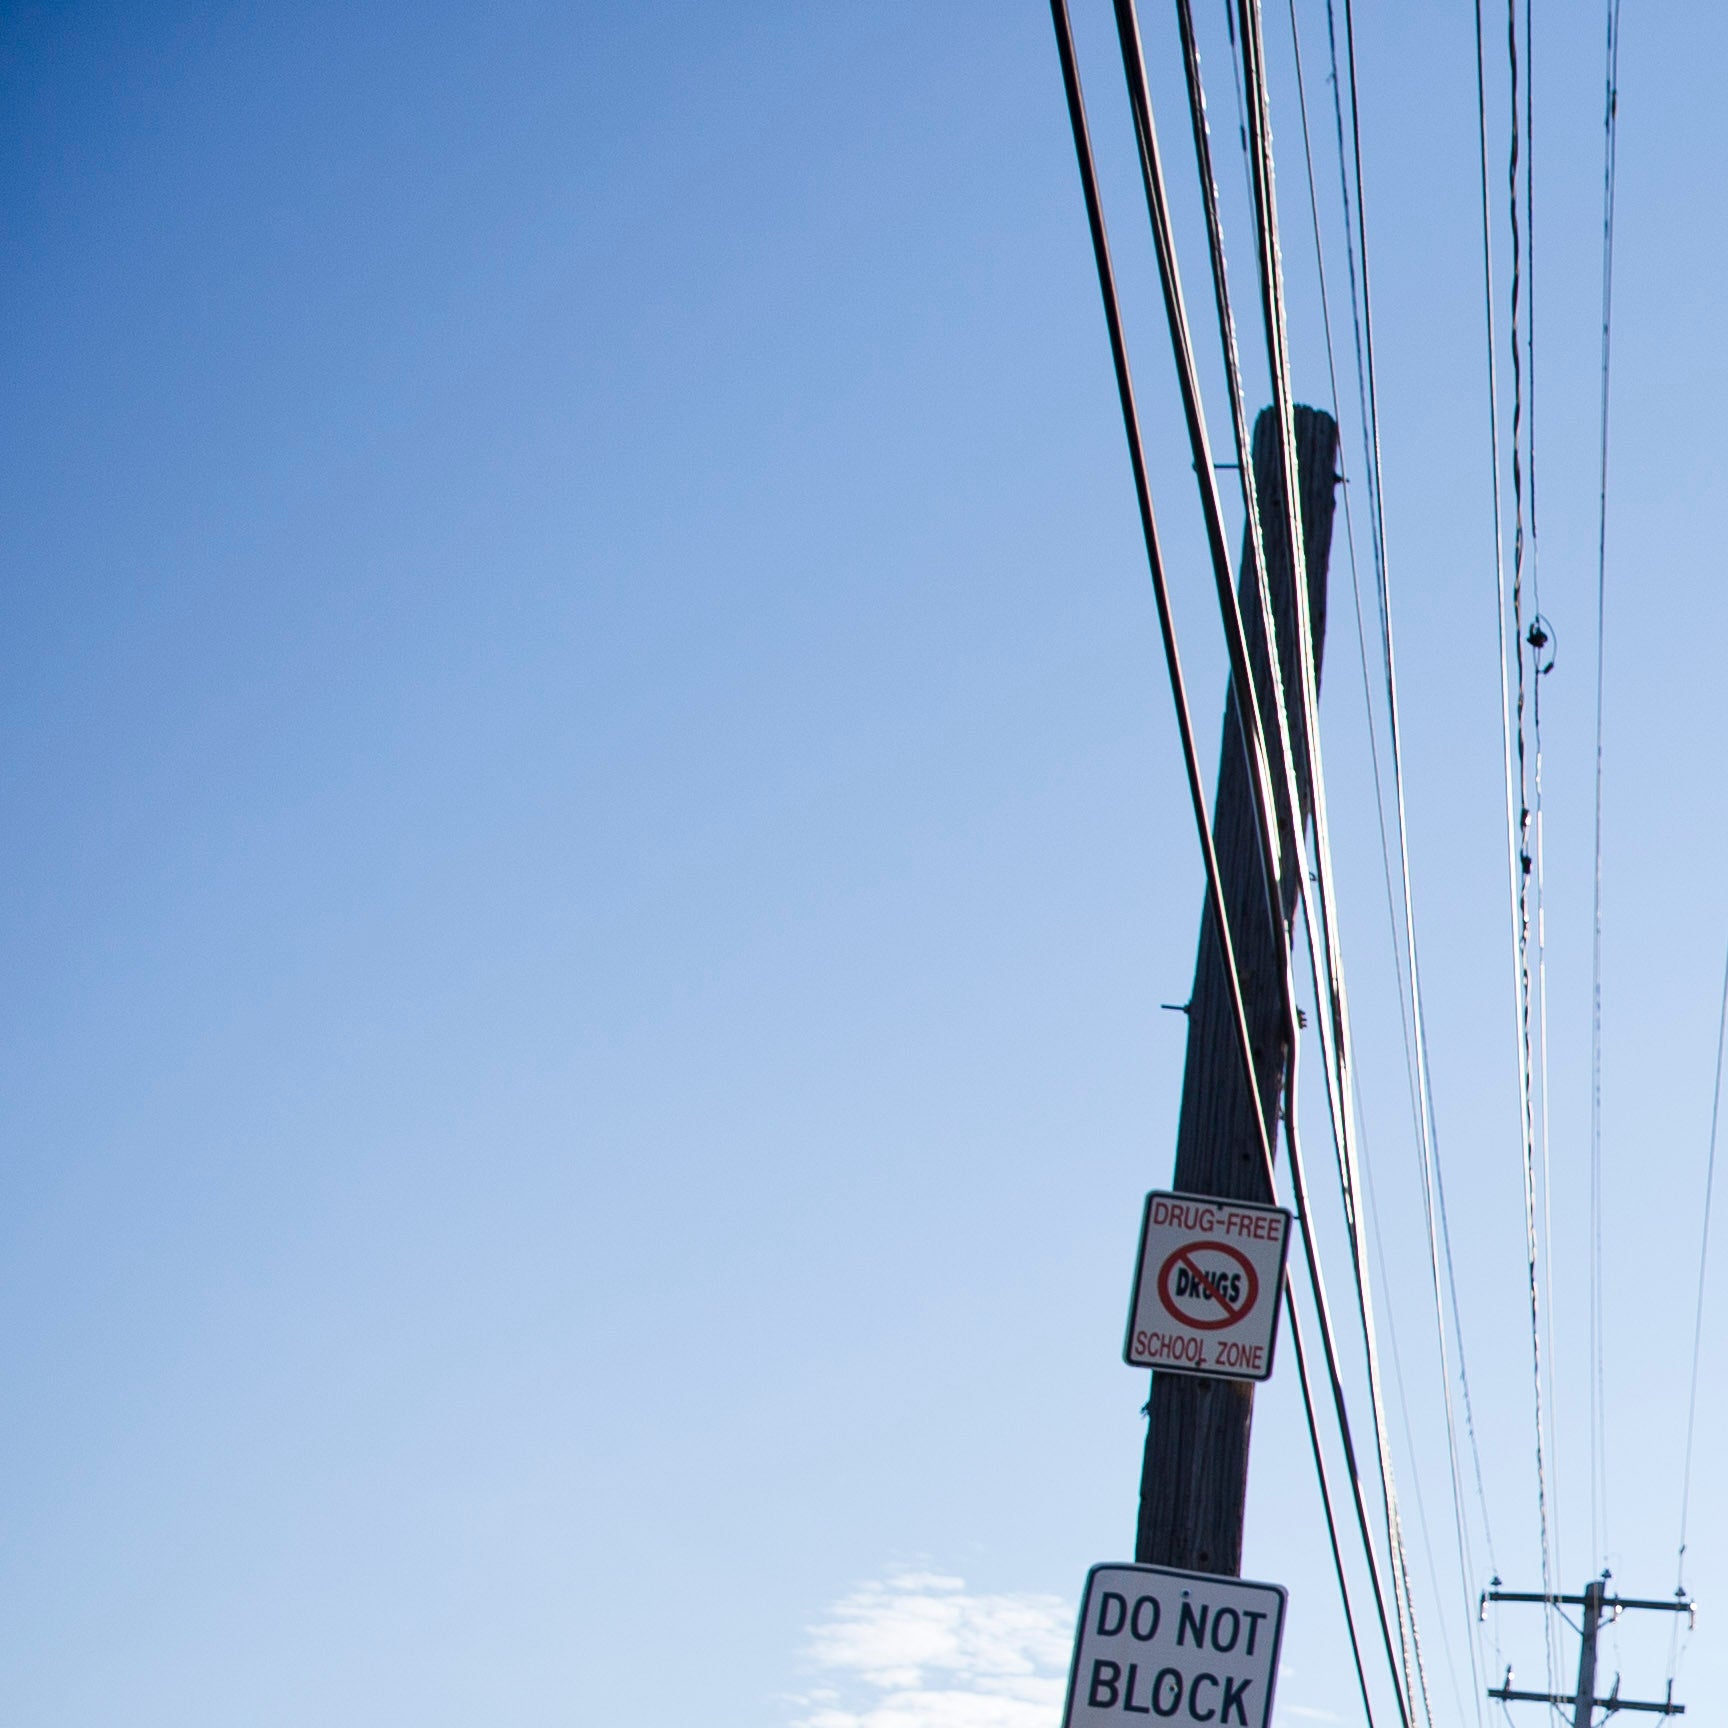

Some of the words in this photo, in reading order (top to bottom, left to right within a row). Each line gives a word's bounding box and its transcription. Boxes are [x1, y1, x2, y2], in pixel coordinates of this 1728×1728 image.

[1153, 1202, 1281, 1241] DRUG-FREE
[1175, 1267, 1242, 1303] DRUGS
[1135, 1331, 1207, 1364] SCHOOL
[1215, 1341, 1263, 1370] ZONE
[1097, 1591, 1161, 1642] DO
[1176, 1601, 1267, 1656] NOT
[1088, 1658, 1253, 1727] BLOCK
